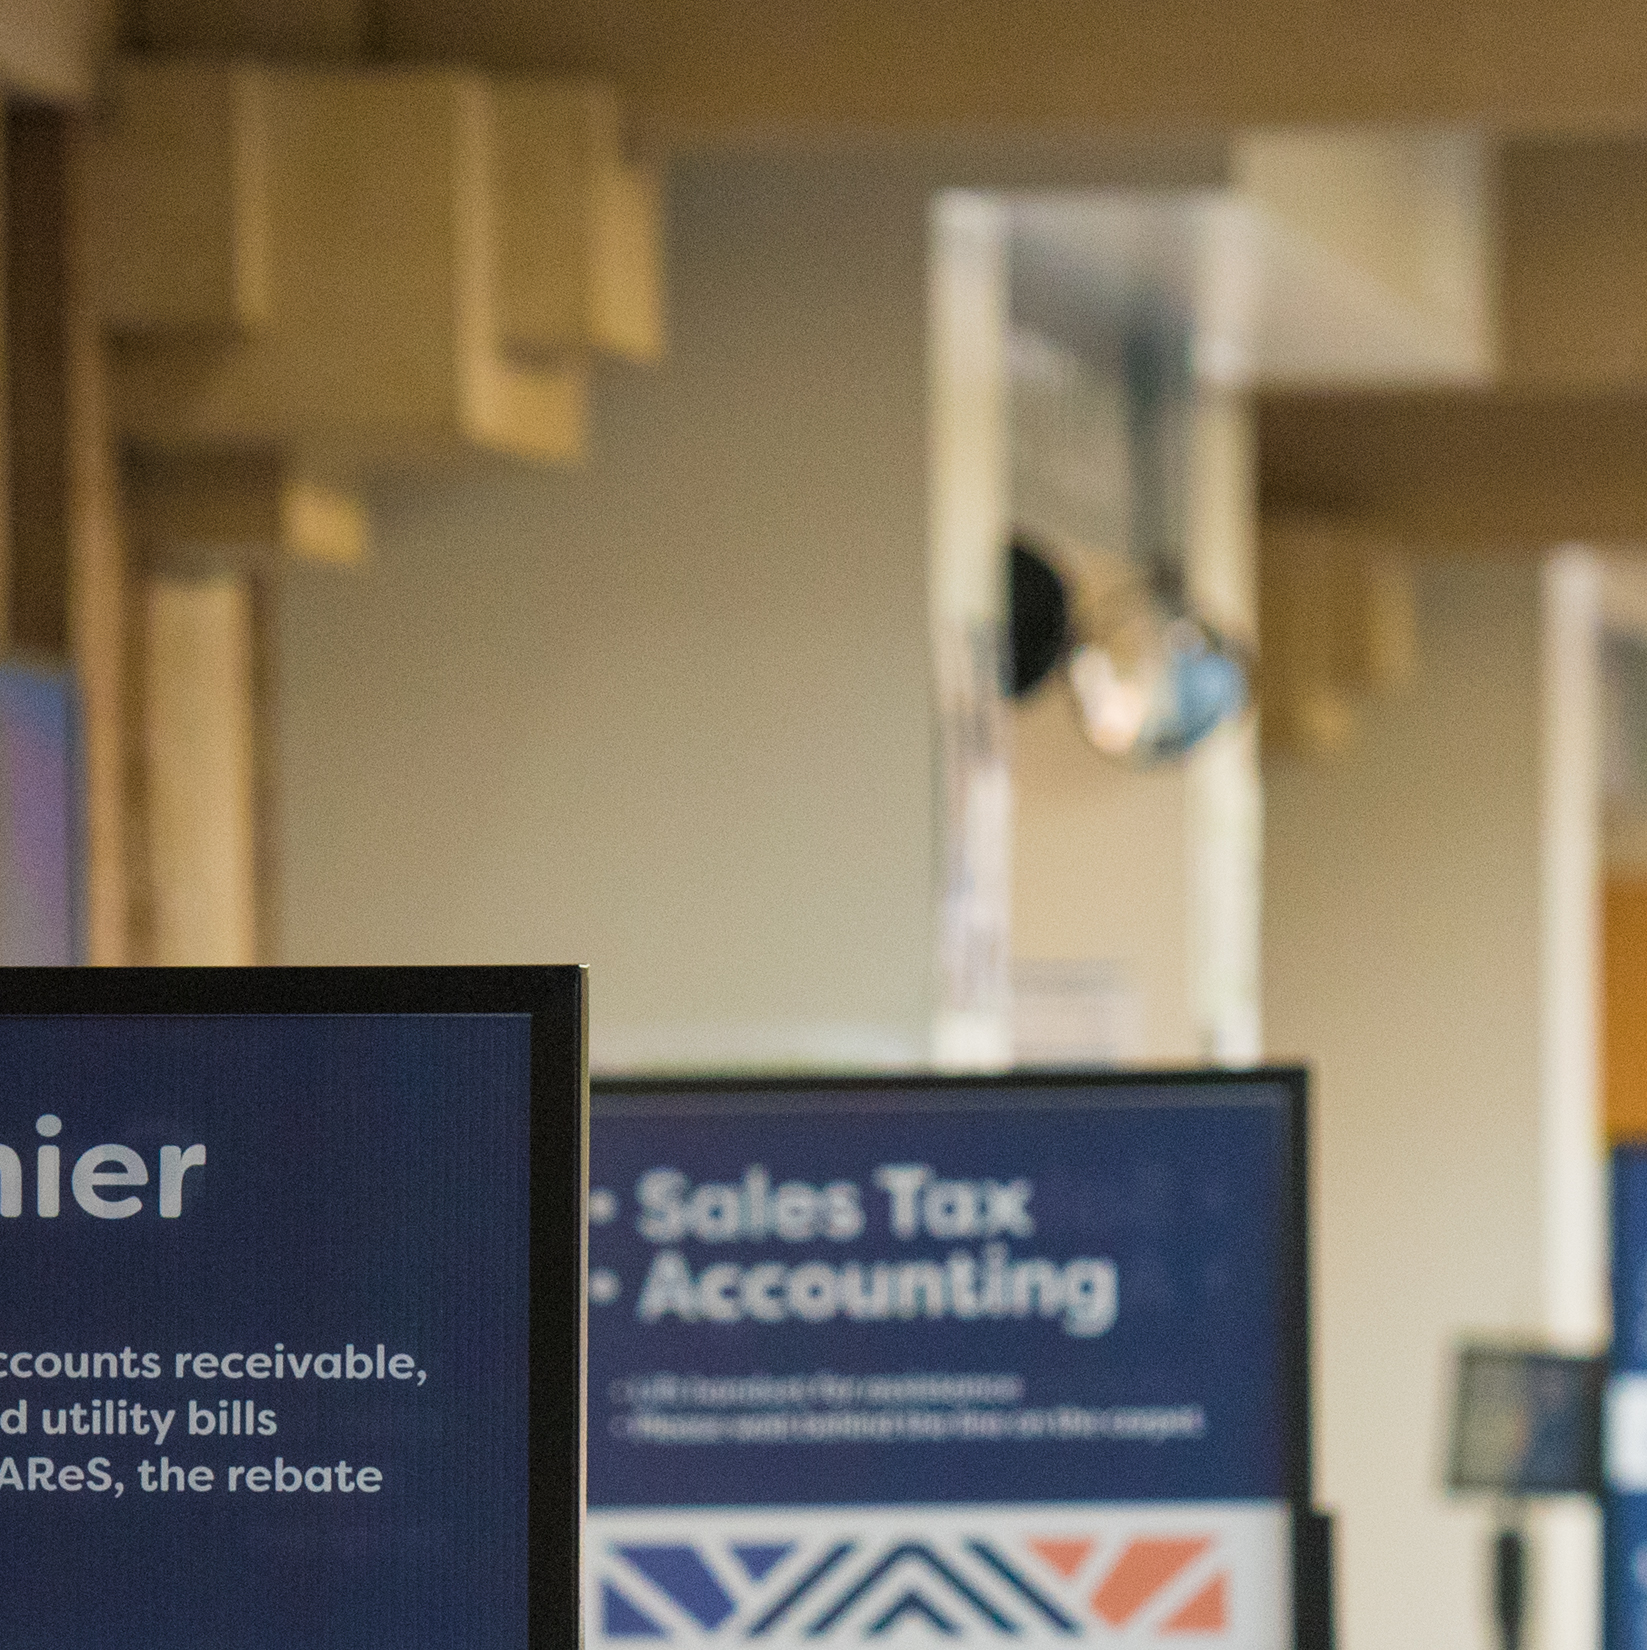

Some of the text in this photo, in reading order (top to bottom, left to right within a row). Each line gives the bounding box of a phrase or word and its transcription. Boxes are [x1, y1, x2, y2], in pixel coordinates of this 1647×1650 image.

[635, 1162, 1036, 1244] Sales Tax
[636, 1242, 1120, 1338] Accounting
[173, 1341, 429, 1387] receivable,
[40, 1397, 178, 1447] utility
[186, 1398, 280, 1438] bills
[136, 1454, 217, 1494] the
[226, 1455, 385, 1495] rebate
